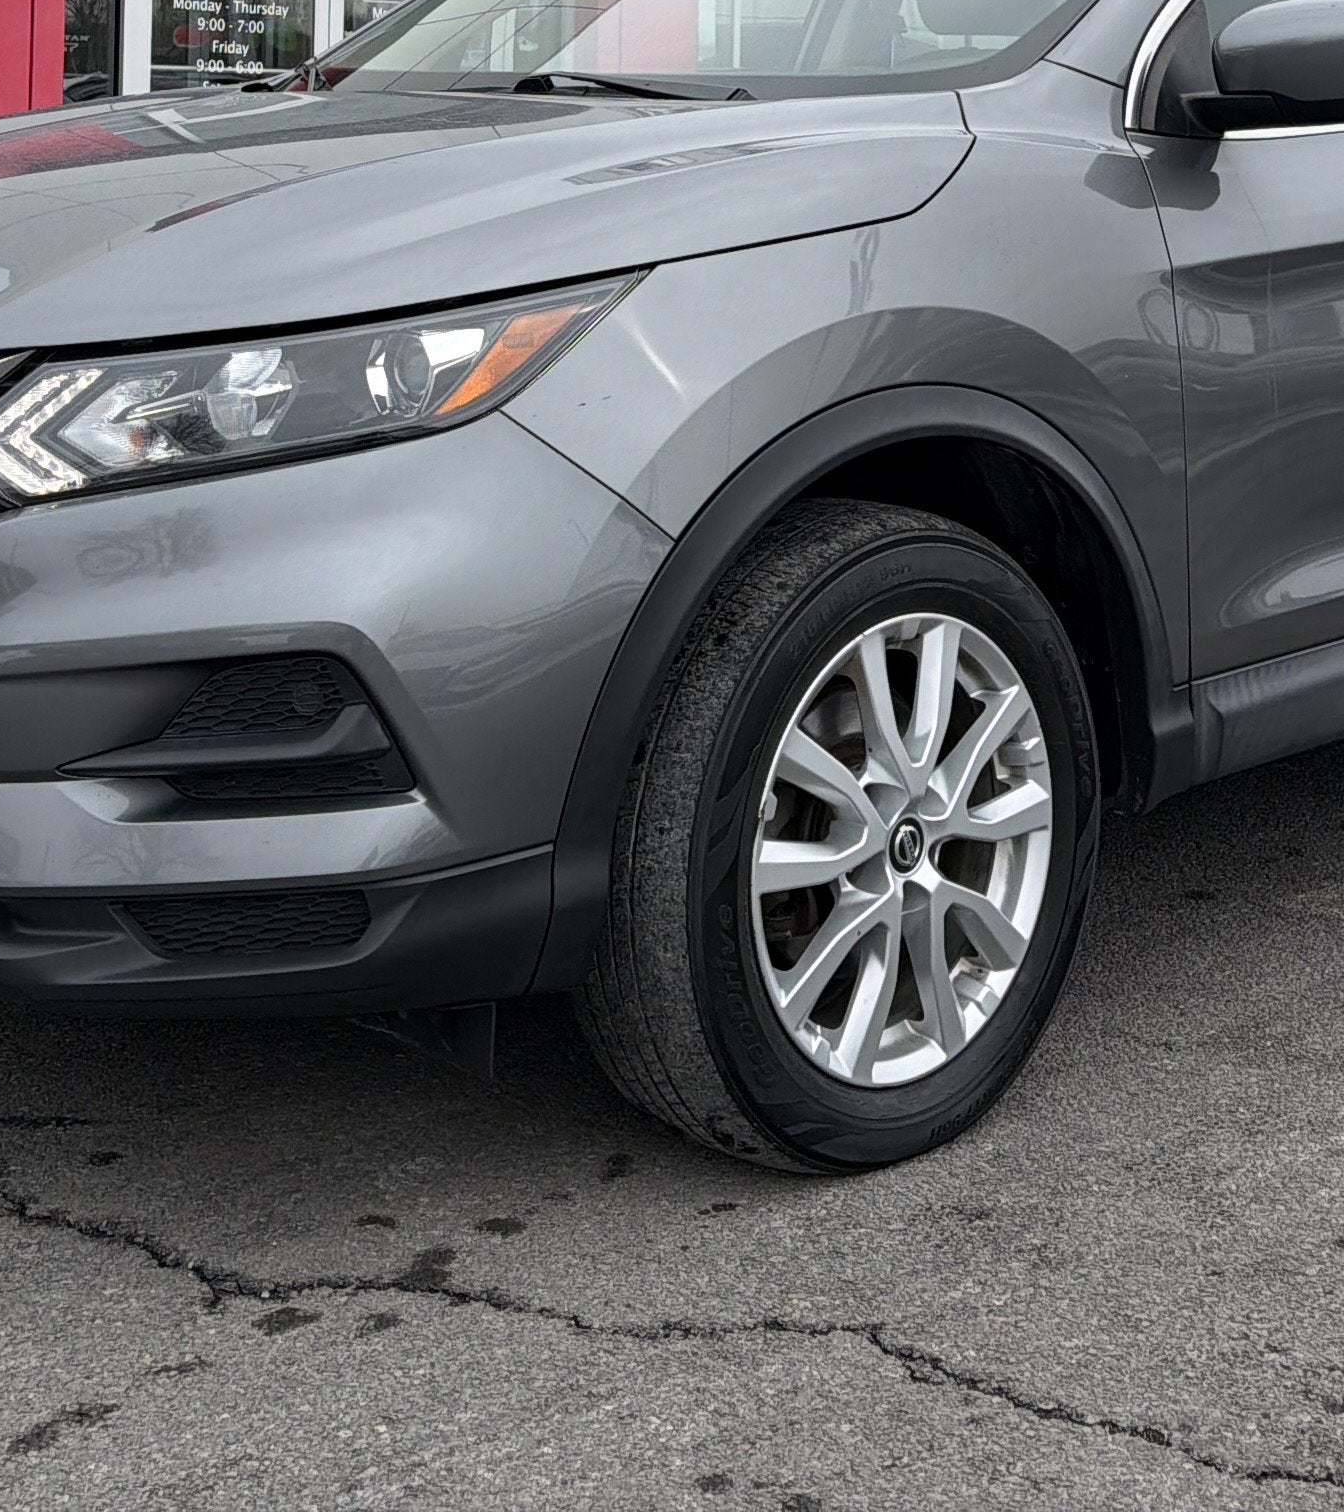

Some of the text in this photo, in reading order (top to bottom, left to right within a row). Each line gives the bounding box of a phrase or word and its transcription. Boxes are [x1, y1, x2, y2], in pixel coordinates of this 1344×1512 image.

[233, 0, 290, 19] Thursday
[197, 17, 226, 32] 9:00
[237, 20, 265, 33] 7:00
[212, 40, 250, 56] Friday
[196, 59, 225, 73] 9:00
[236, 61, 264, 74] 6:00
